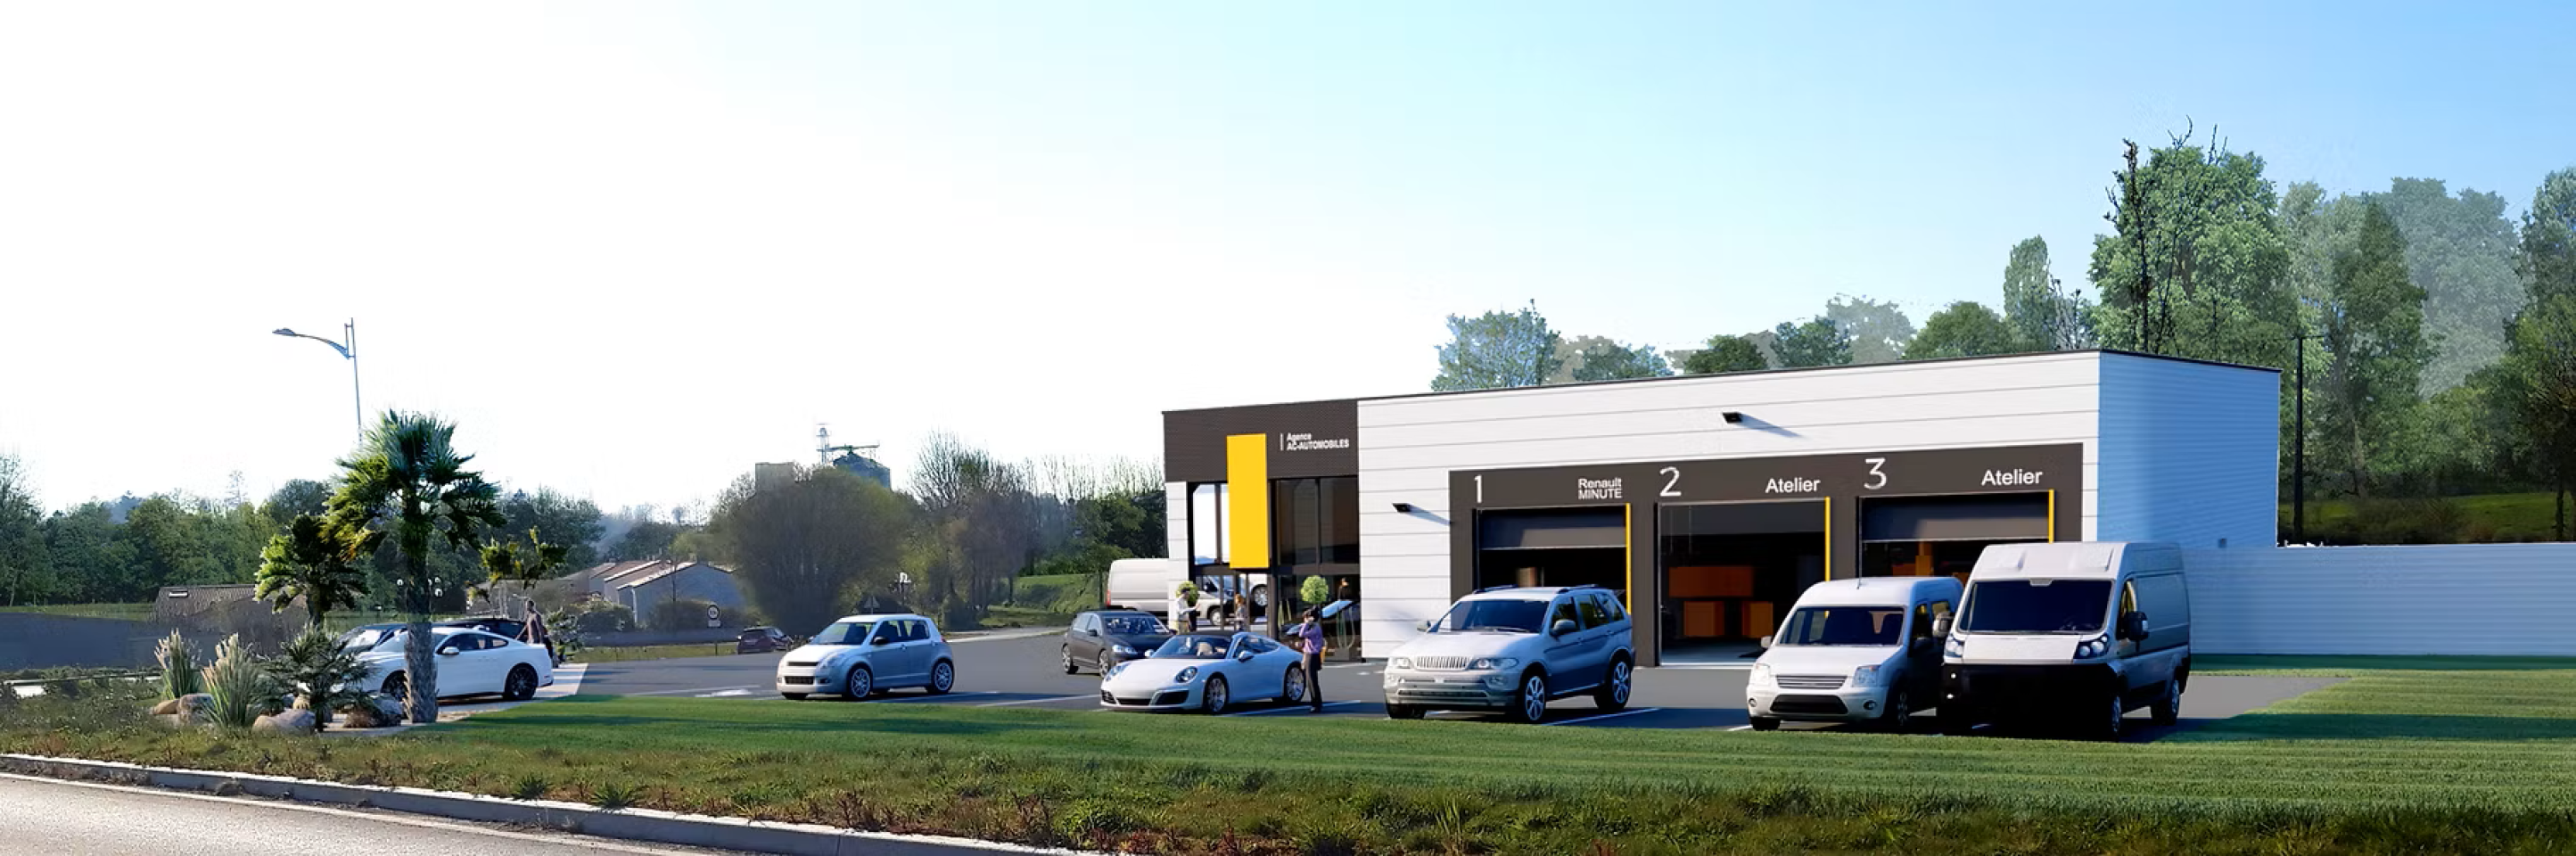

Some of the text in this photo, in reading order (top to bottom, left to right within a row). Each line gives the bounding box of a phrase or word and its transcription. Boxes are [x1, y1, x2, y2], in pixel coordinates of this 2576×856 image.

[1659, 466, 1682, 497] 2
[1864, 457, 1887, 490] 3
[1981, 469, 2044, 486] Atelier
[1474, 474, 1483, 504] 1
[1577, 477, 1622, 489] Renault
[1765, 477, 1821, 494] Atelier
[1577, 489, 1623, 500] MINUTE
